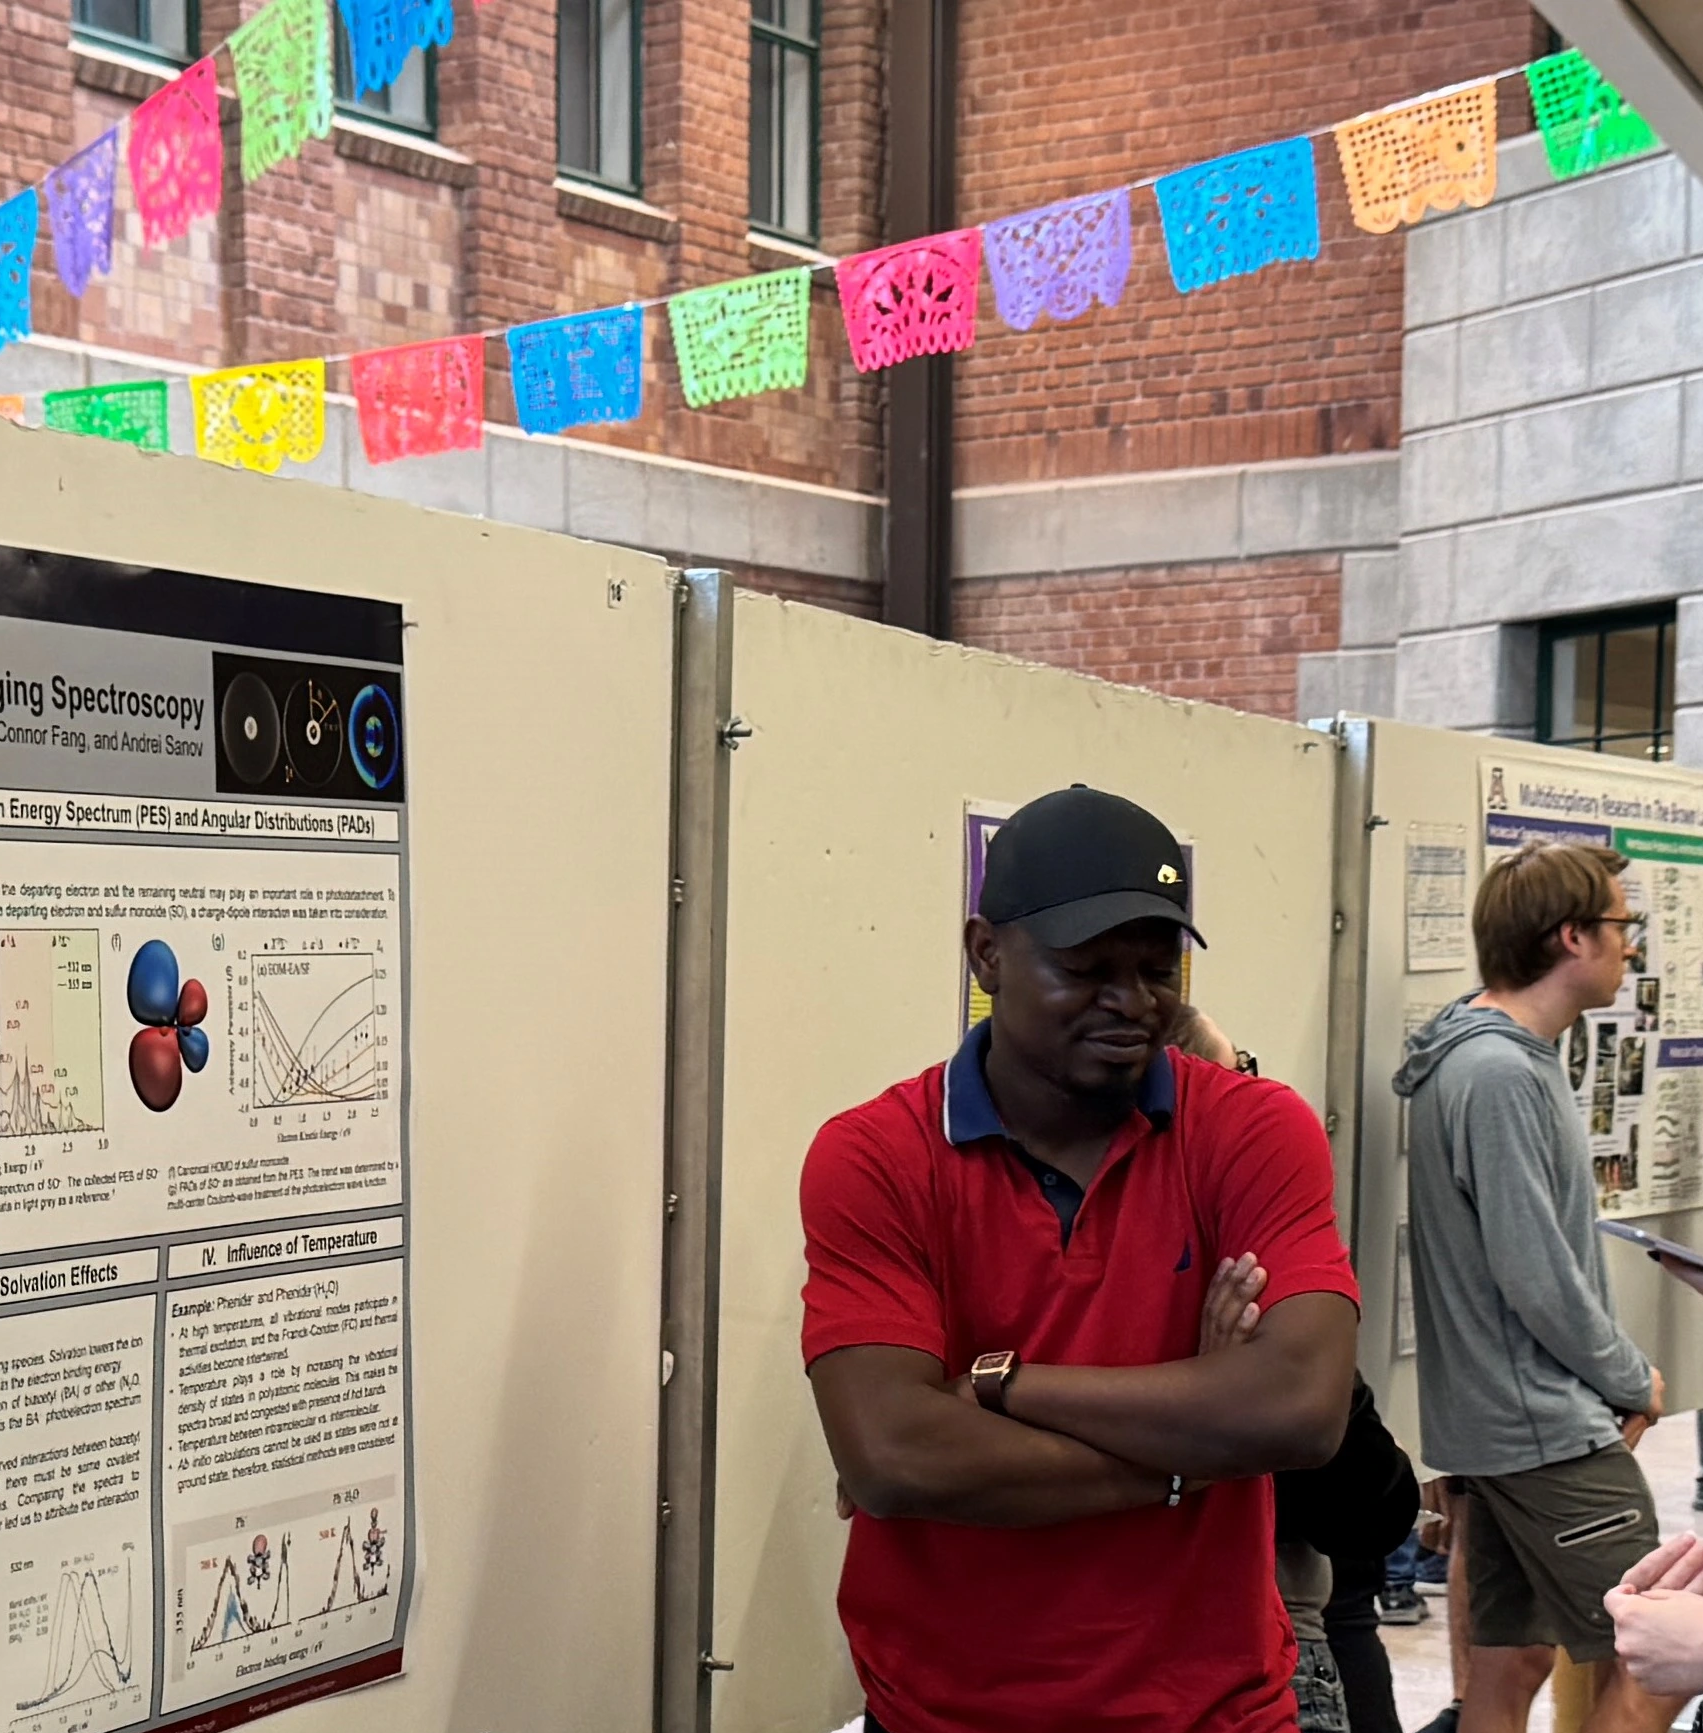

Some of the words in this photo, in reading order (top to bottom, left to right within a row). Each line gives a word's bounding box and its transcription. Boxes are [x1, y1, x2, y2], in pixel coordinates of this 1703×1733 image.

[51, 675, 204, 729] Spectroscopy
[52, 725, 90, 753] Fang,
[94, 731, 118, 751] and
[121, 732, 163, 754] Andrei
[165, 736, 203, 757] Sanov
[10, 799, 61, 825] Energy
[66, 802, 131, 826] Spectrum
[135, 805, 171, 830] (PES)
[175, 808, 198, 827] and
[201, 809, 251, 832] Angular
[255, 811, 333, 833] Distributions
[337, 815, 375, 838] (PADs)
[202, 1248, 216, 1267] IV.
[227, 1242, 282, 1263] Influence
[286, 1237, 299, 1254] of
[301, 1231, 377, 1254] Temperature
[71, 1264, 118, 1285] Effects
